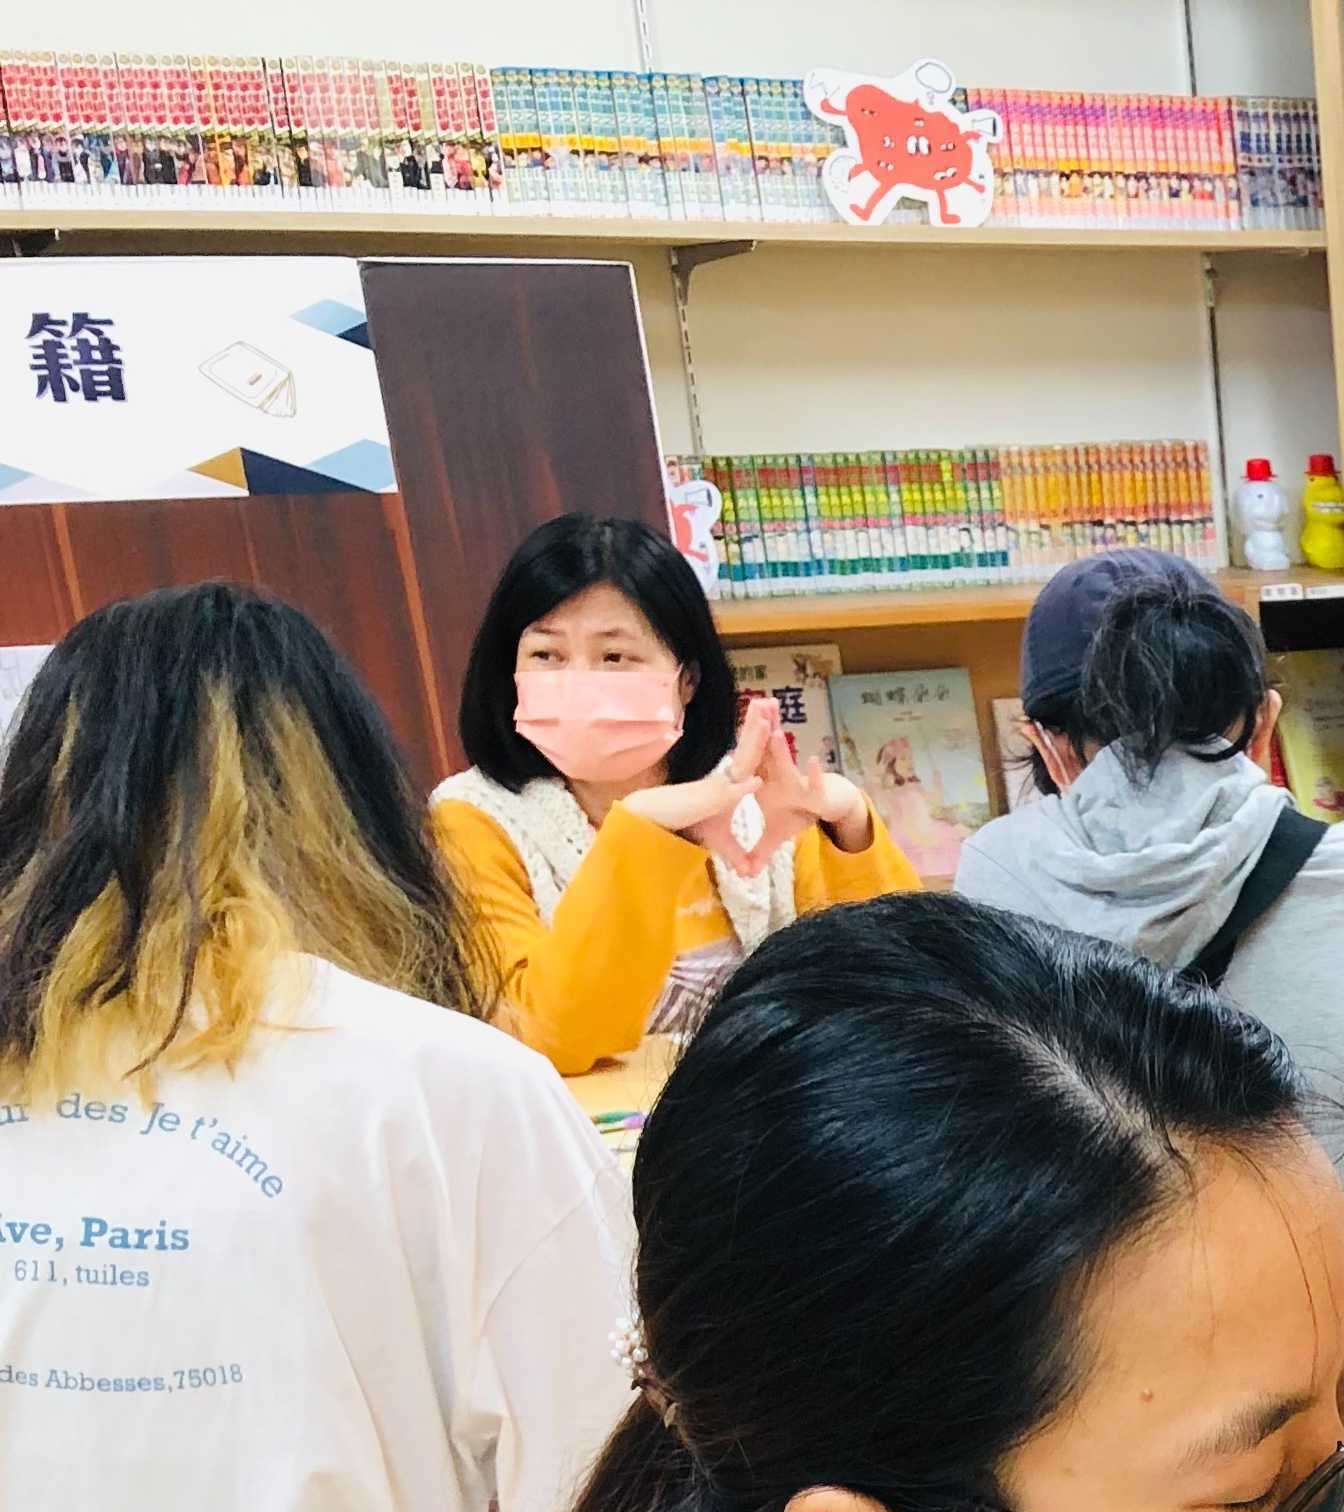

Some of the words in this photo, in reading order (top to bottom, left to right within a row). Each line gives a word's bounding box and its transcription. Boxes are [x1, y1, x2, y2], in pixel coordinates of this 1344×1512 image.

[25, 311, 127, 402] 籍
[56, 1093, 129, 1124] des
[79, 1216, 190, 1251] Paris
[75, 1264, 151, 1287] tuiles
